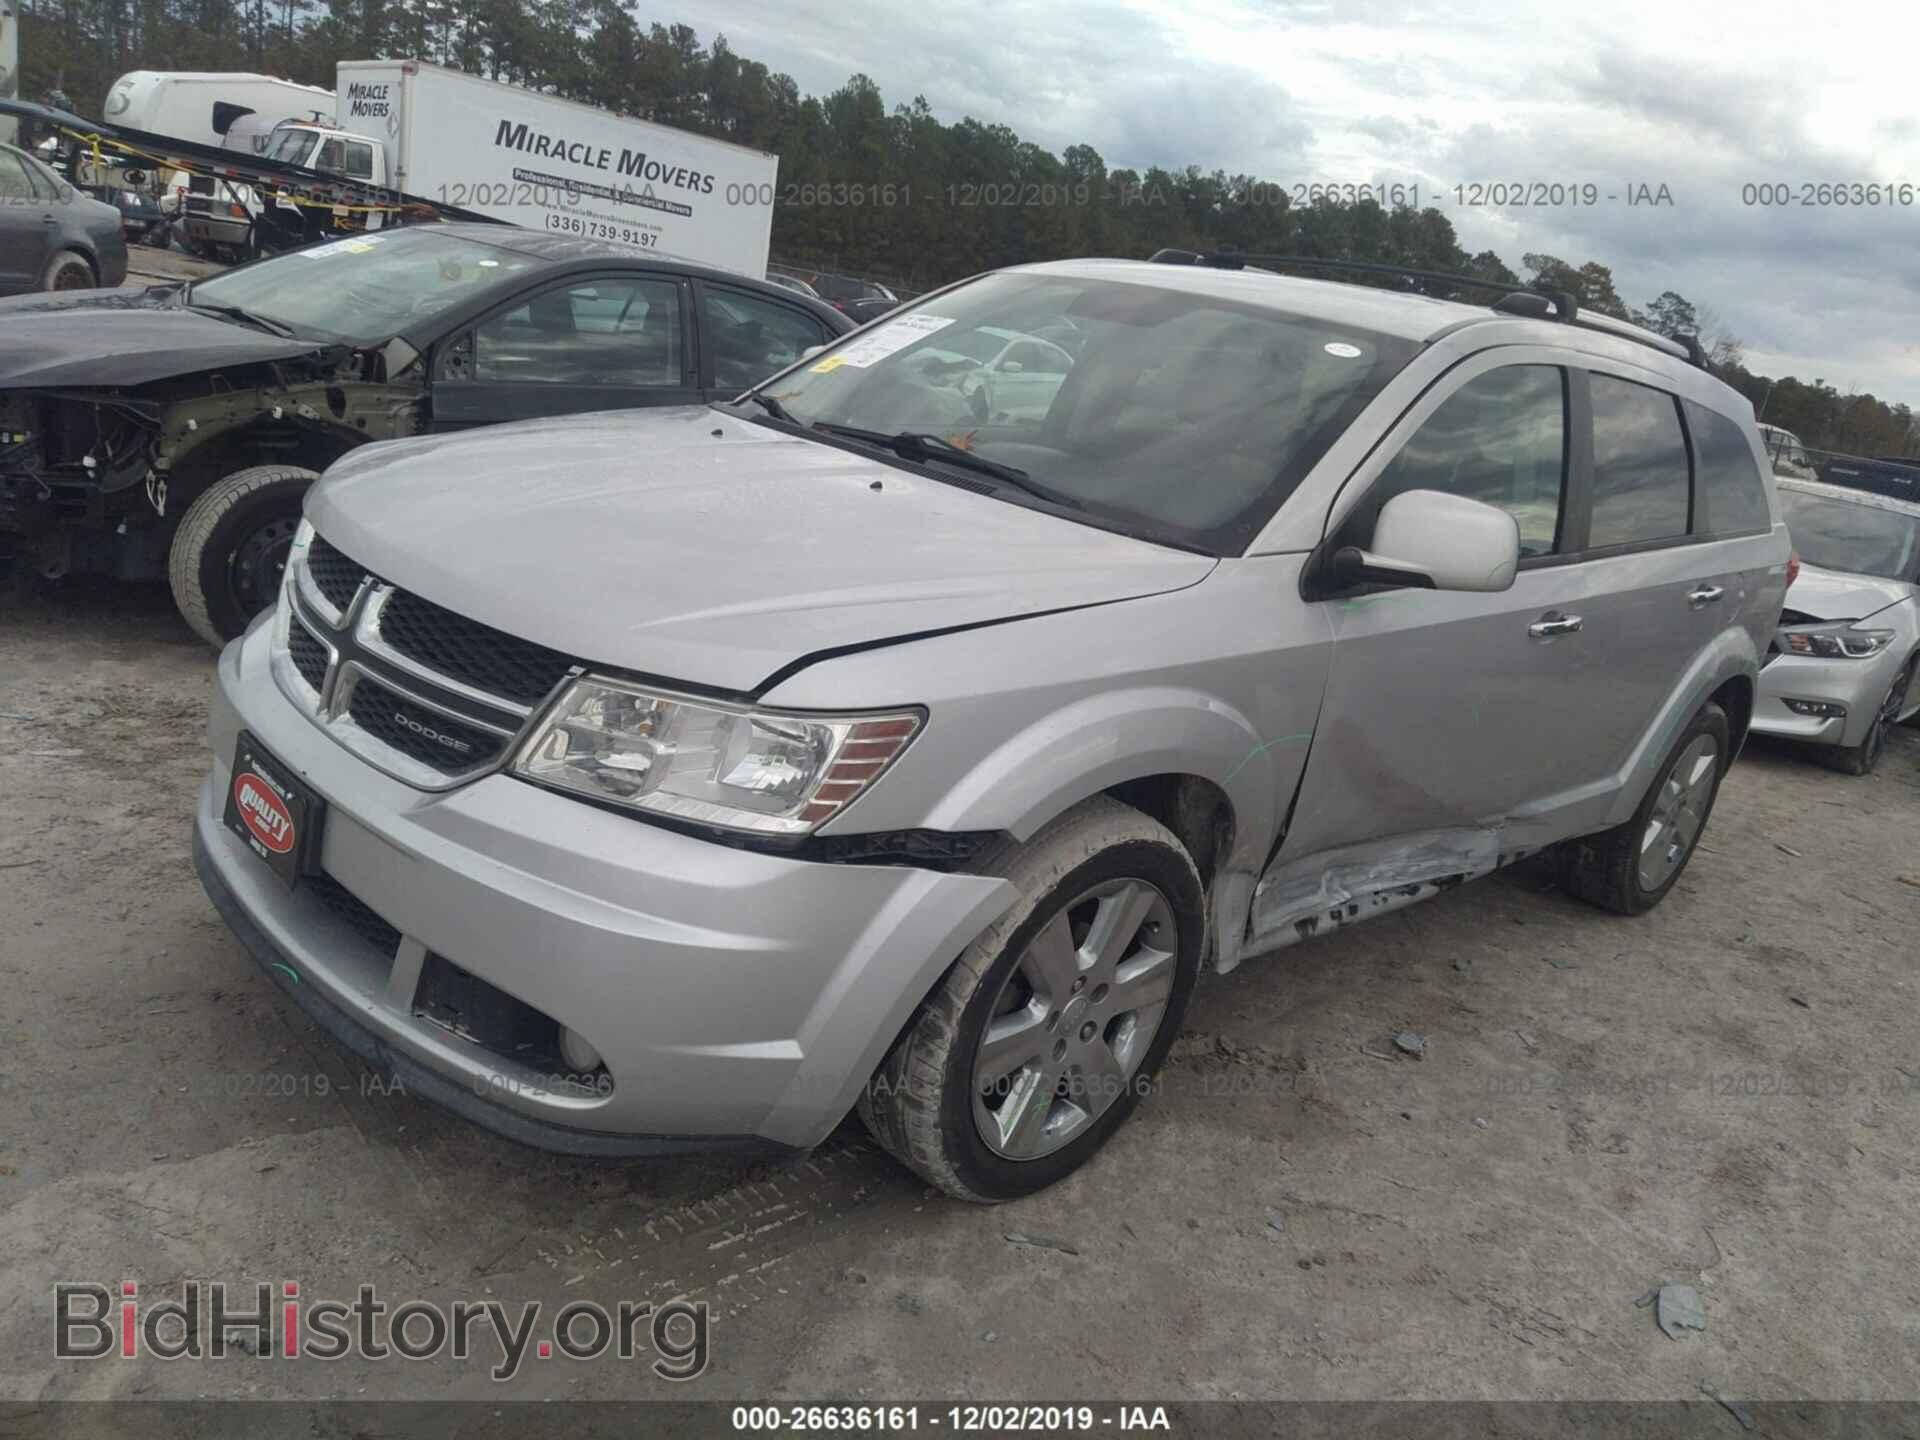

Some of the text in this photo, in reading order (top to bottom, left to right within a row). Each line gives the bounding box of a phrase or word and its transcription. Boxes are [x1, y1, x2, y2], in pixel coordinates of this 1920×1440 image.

[347, 82, 389, 100] MIRACLE
[350, 100, 390, 117] MOVERS
[495, 119, 716, 194] MIRACLE MOVERS
[544, 214, 658, 247] (336) 739-9197
[394, 712, 471, 752] DODGE
[240, 783, 290, 842] QUALITY
